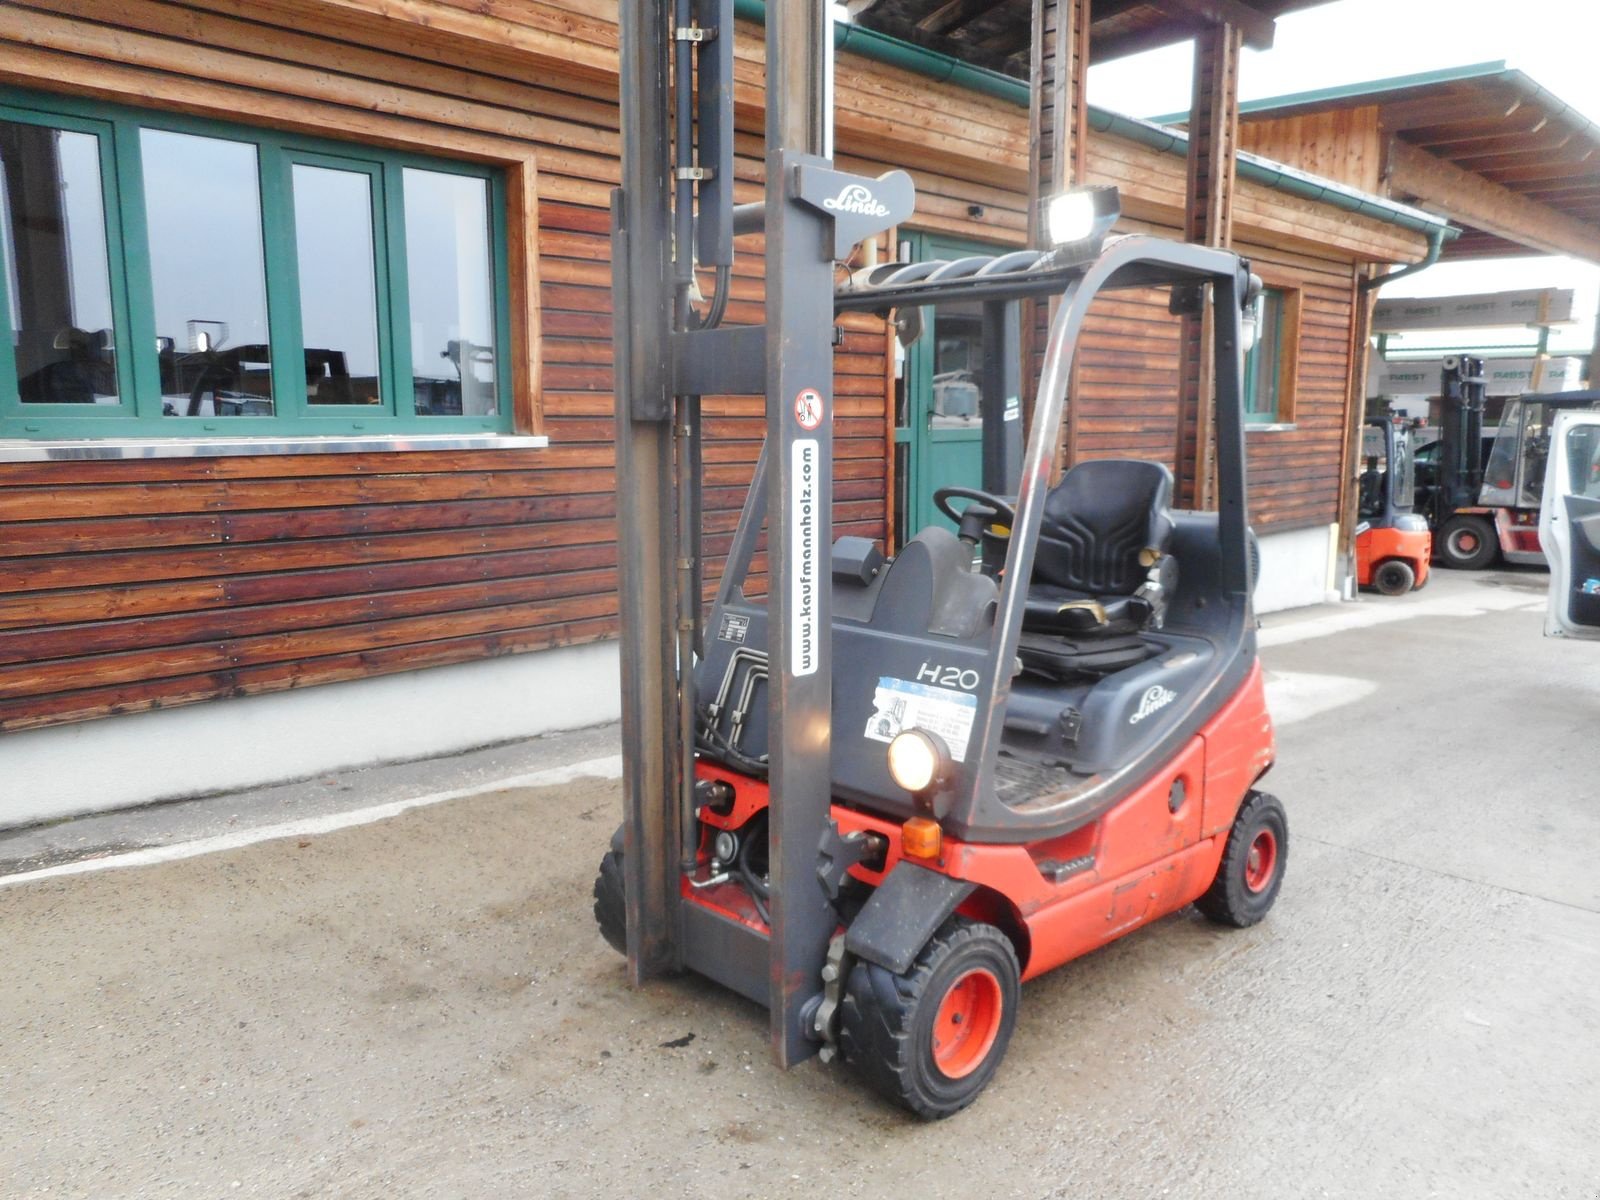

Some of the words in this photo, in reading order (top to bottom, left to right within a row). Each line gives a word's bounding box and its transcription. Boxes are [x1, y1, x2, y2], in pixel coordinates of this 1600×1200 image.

[823, 184, 891, 217] Linde
[800, 447, 812, 669] www.kaufmannholz.com
[916, 662, 980, 690] H20
[1129, 684, 1177, 724] Linde
